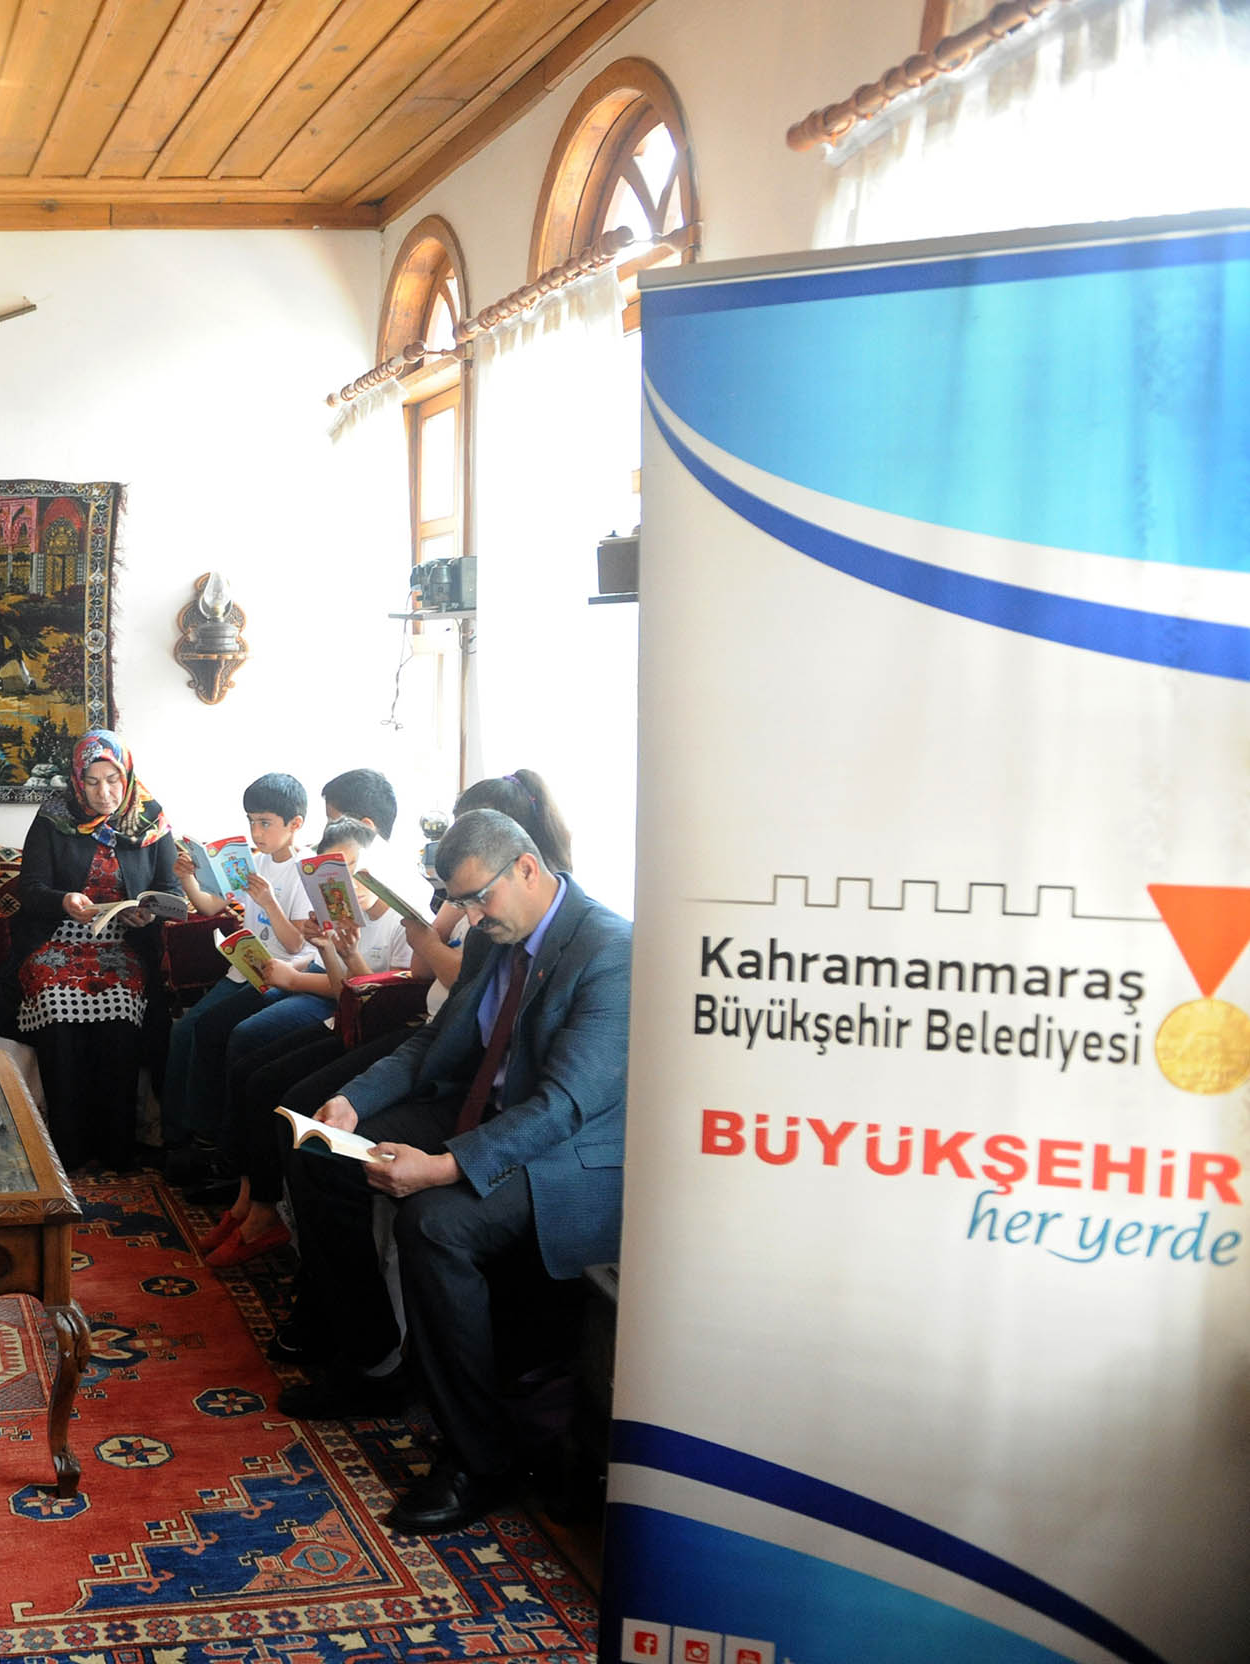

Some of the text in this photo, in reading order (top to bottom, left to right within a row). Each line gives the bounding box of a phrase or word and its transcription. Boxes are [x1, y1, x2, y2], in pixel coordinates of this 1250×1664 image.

[700, 934, 1145, 1016] Kahramanmaraş
[693, 993, 1141, 1073] Büyükşehir Belediyesi
[966, 1189, 1243, 1267] her yerde
